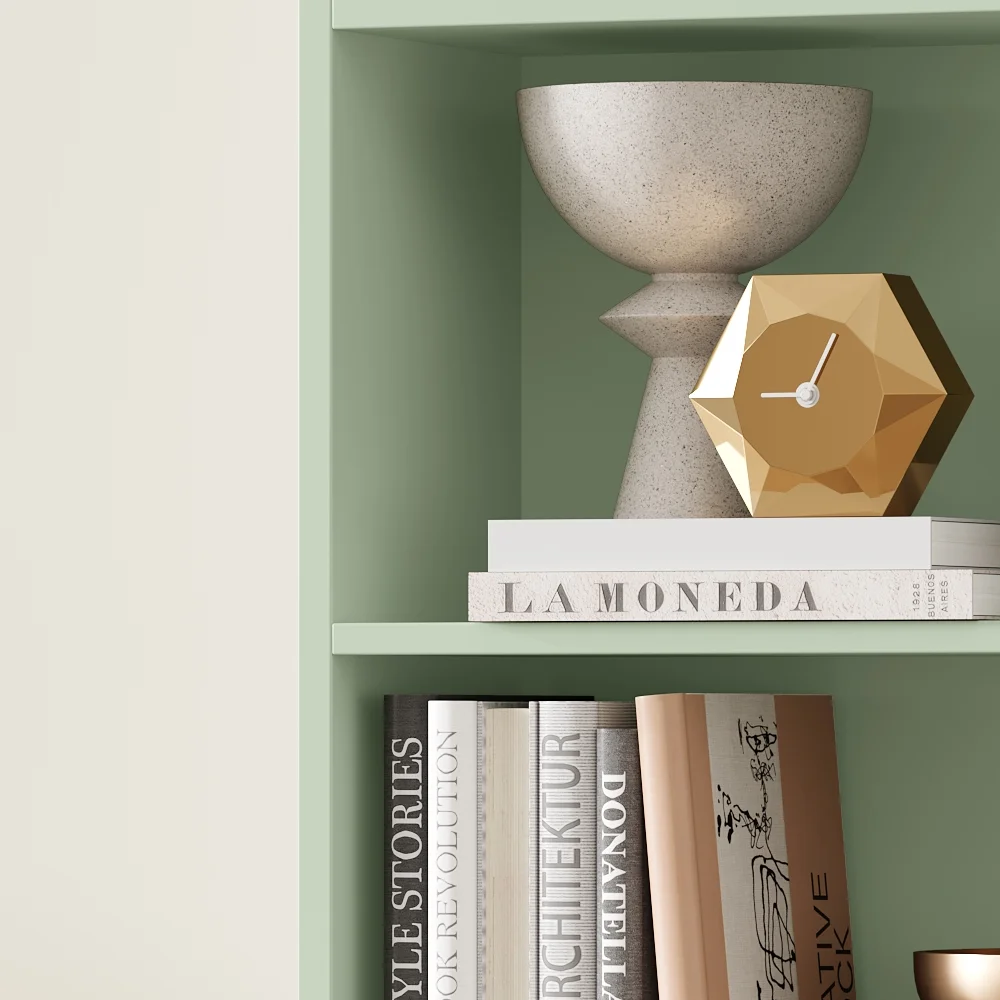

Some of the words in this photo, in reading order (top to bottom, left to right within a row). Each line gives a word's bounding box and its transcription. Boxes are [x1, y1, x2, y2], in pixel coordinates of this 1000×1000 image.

[498, 581, 575, 614] LA
[594, 580, 822, 614] MONEDA
[912, 583, 920, 611] 1928
[927, 573, 936, 618] BUENOS
[940, 580, 948, 613] AIRES
[391, 737, 423, 911] STORIES
[436, 731, 459, 940] REVOLUTION
